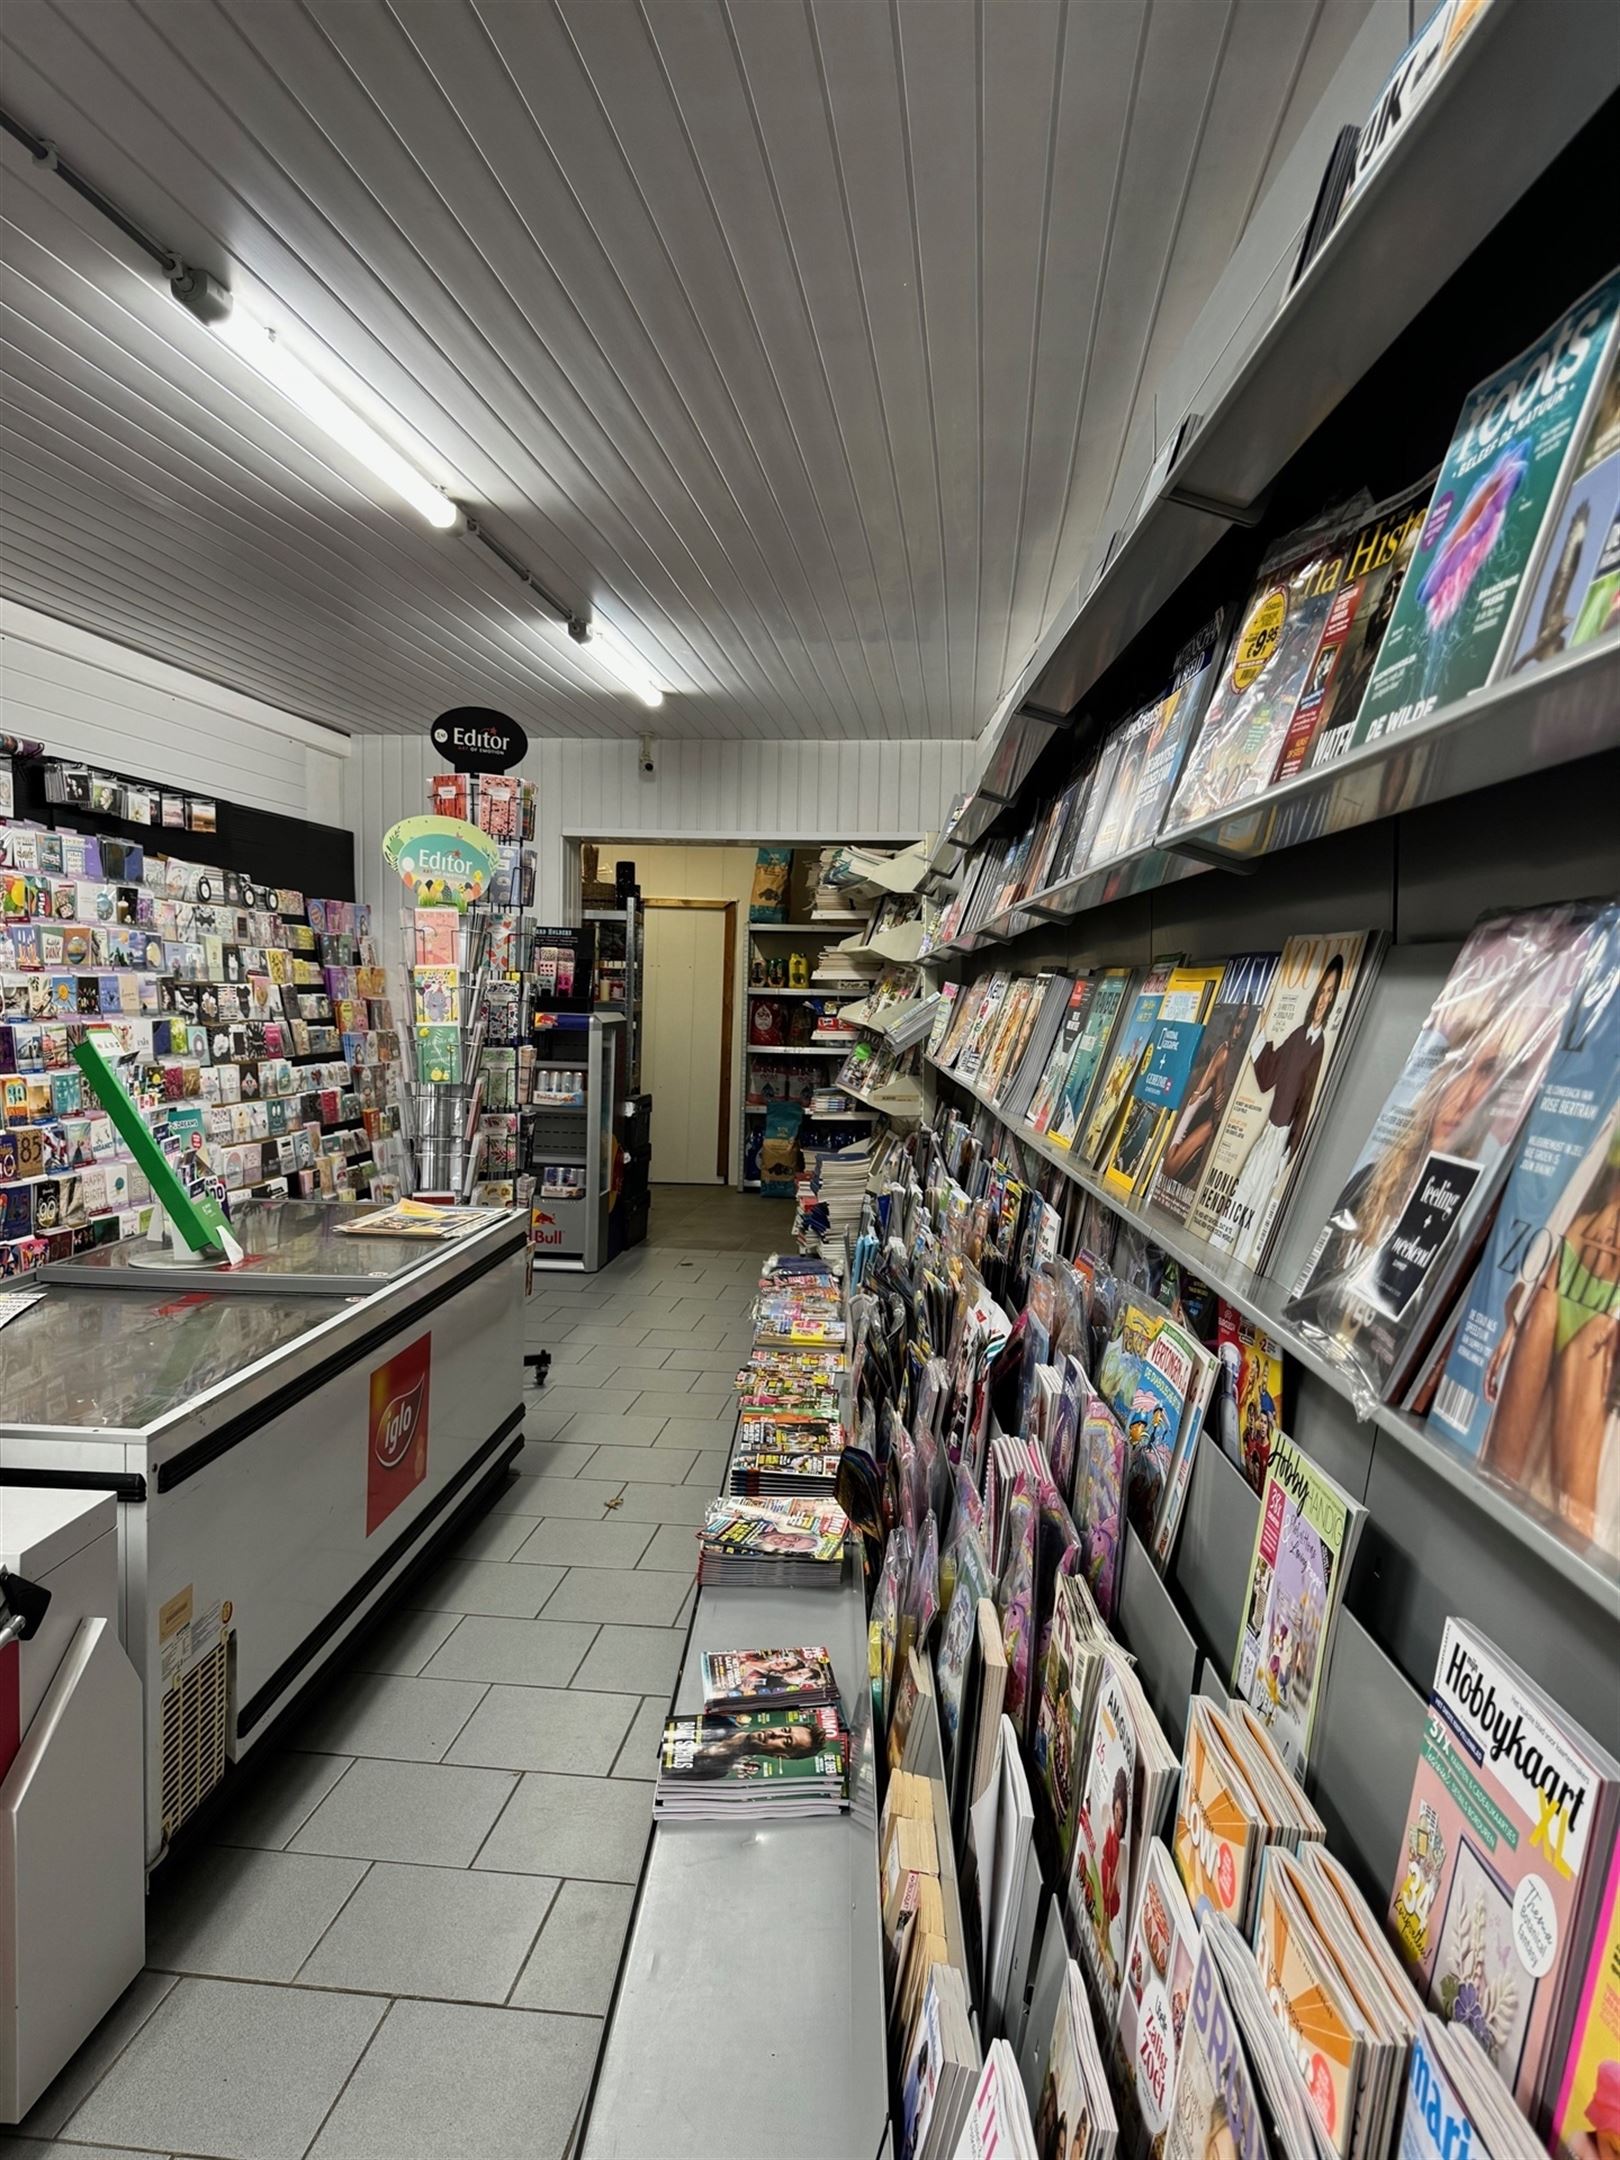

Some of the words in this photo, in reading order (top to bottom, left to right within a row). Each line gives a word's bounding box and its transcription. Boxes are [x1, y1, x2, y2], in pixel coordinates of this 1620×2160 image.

[1456, 307, 1601, 462] roots
[1459, 441, 1498, 478] BELEEF
[1515, 388, 1568, 434] NATUUR
[454, 727, 510, 750] Editor
[1364, 716, 1385, 743] DE
[1385, 695, 1438, 734] WILDE
[419, 849, 472, 874] Editor
[20, 1134, 41, 1163] 85
[1205, 1168, 1239, 1196] MONIC
[1420, 1176, 1460, 1221] feeling
[1202, 1184, 1256, 1230] HENDRICKX
[535, 1230, 562, 1244] Bull
[1391, 1236, 1438, 1268] weekend
[385, 1402, 412, 1454] iglo
[1268, 1434, 1310, 1517] Hobby
[818, 1708, 837, 1740] HUMO
[1446, 1642, 1586, 1833] Hobbykaart
[1528, 1786, 1573, 1882] XL
